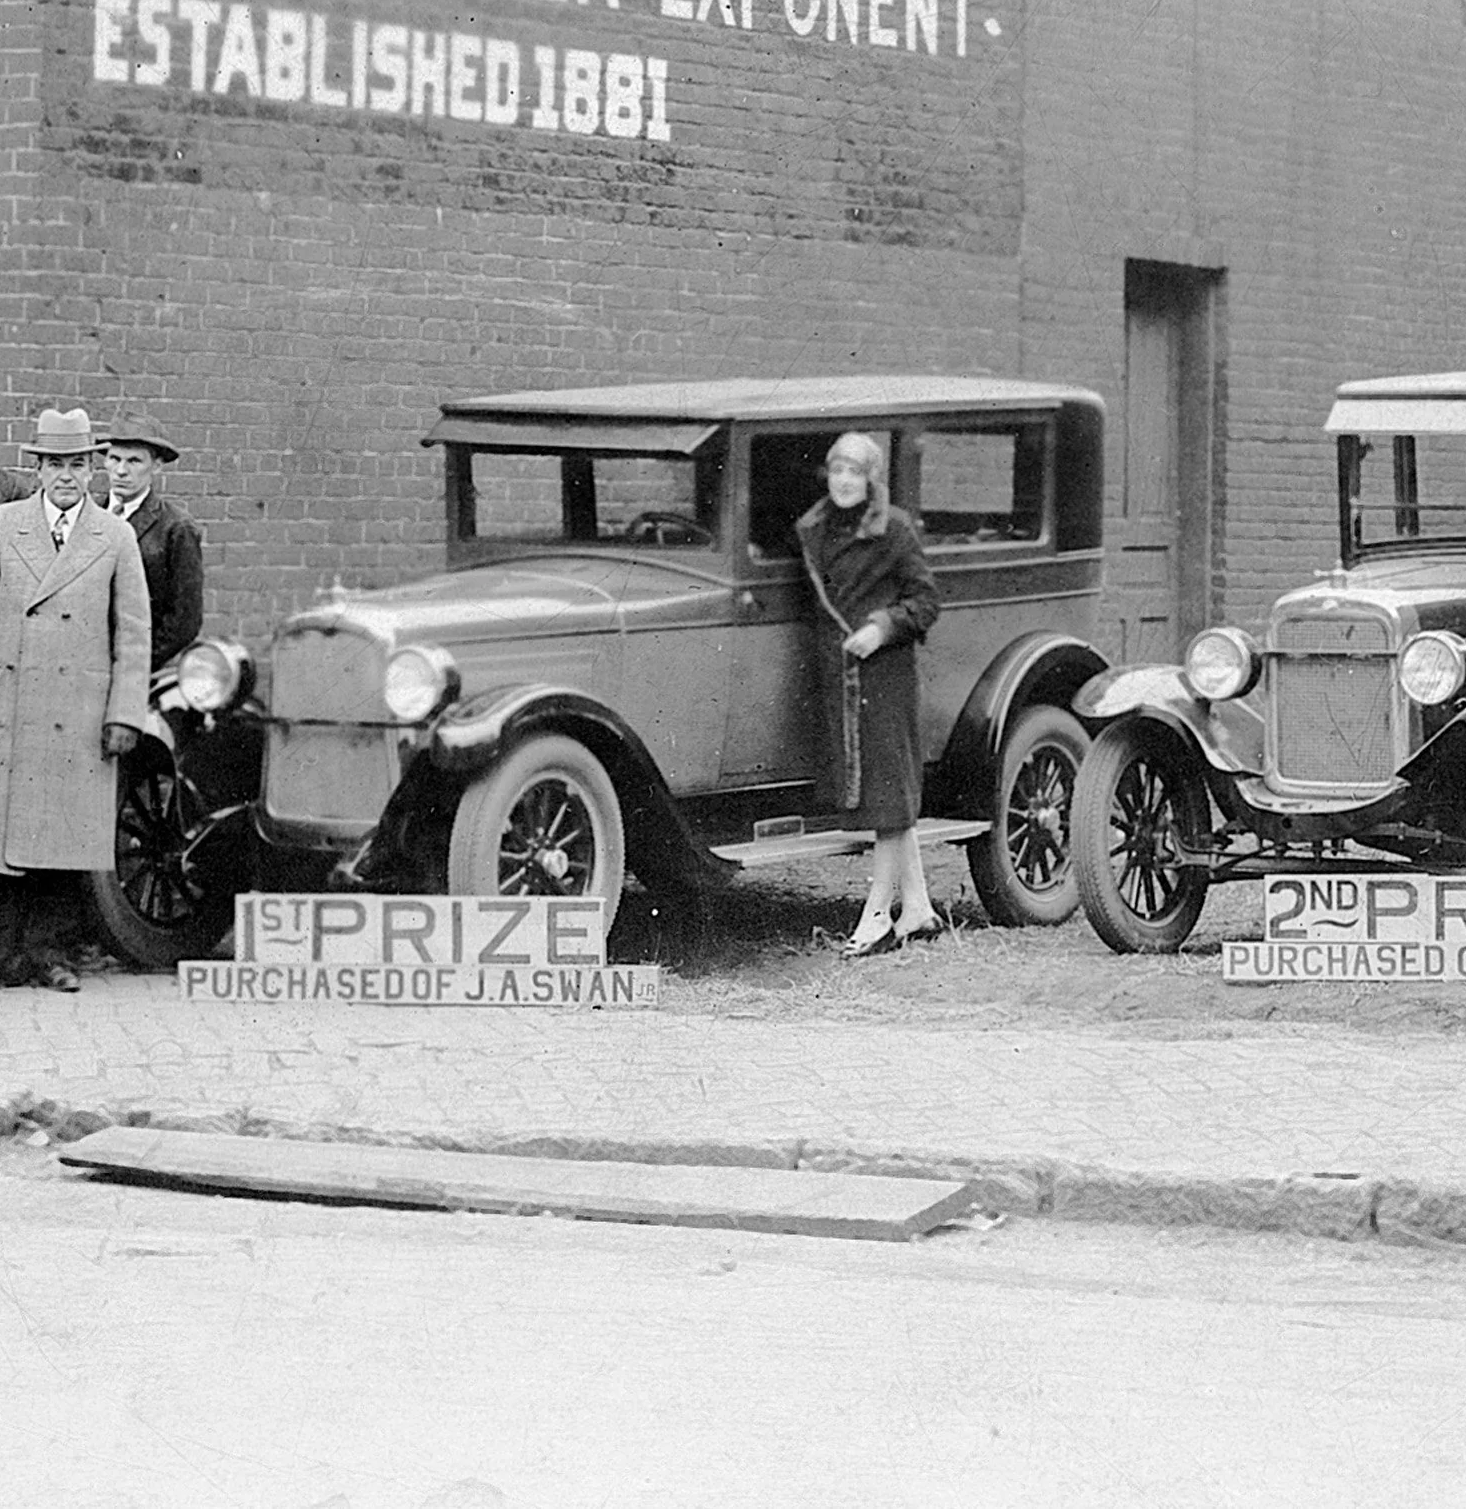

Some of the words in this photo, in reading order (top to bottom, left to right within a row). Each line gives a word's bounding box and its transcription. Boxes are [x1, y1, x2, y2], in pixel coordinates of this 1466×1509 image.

[532, 44, 672, 142] 1881
[242, 898, 307, 964] 1ST
[312, 900, 601, 965] PRIZE
[1268, 879, 1360, 940] 2ND
[636, 982, 656, 997] JR
[1230, 945, 1445, 977] PURCHASED
